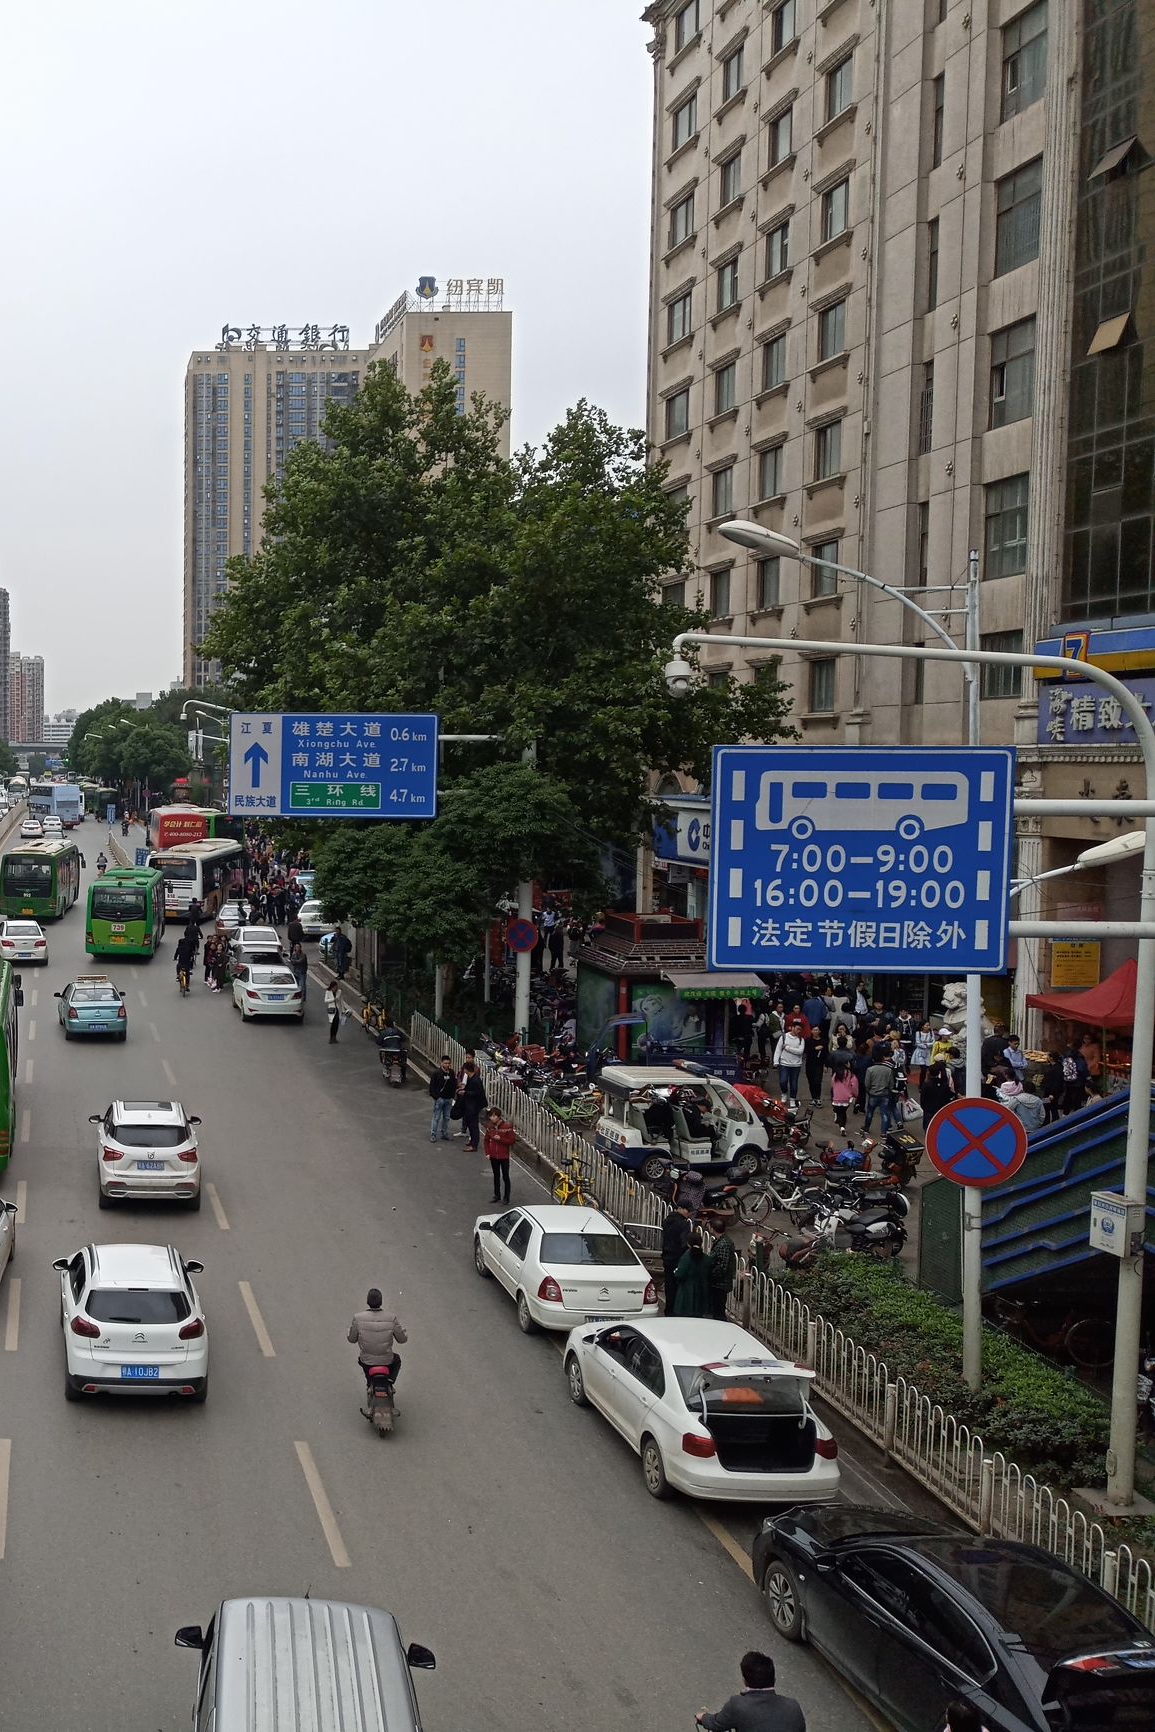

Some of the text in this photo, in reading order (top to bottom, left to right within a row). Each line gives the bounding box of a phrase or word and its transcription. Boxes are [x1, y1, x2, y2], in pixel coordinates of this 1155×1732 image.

[446, 278, 504, 296] 纽宾凯
[241, 722, 273, 734] 江夏
[292, 721, 382, 737] 雄楚大道
[391, 728, 427, 741] 0.6 km
[298, 739, 350, 749] Xiongchu
[292, 752, 381, 768] 南湖大道
[390, 759, 426, 772] 2.7 km
[303, 770, 339, 778] Nanhu
[295, 784, 377, 797] 三环线
[389, 789, 426, 803] 4.7 km
[234, 795, 276, 808] 民族大道
[326, 798, 346, 807] Ring
[751, 918, 967, 949] 法定节假日除外
